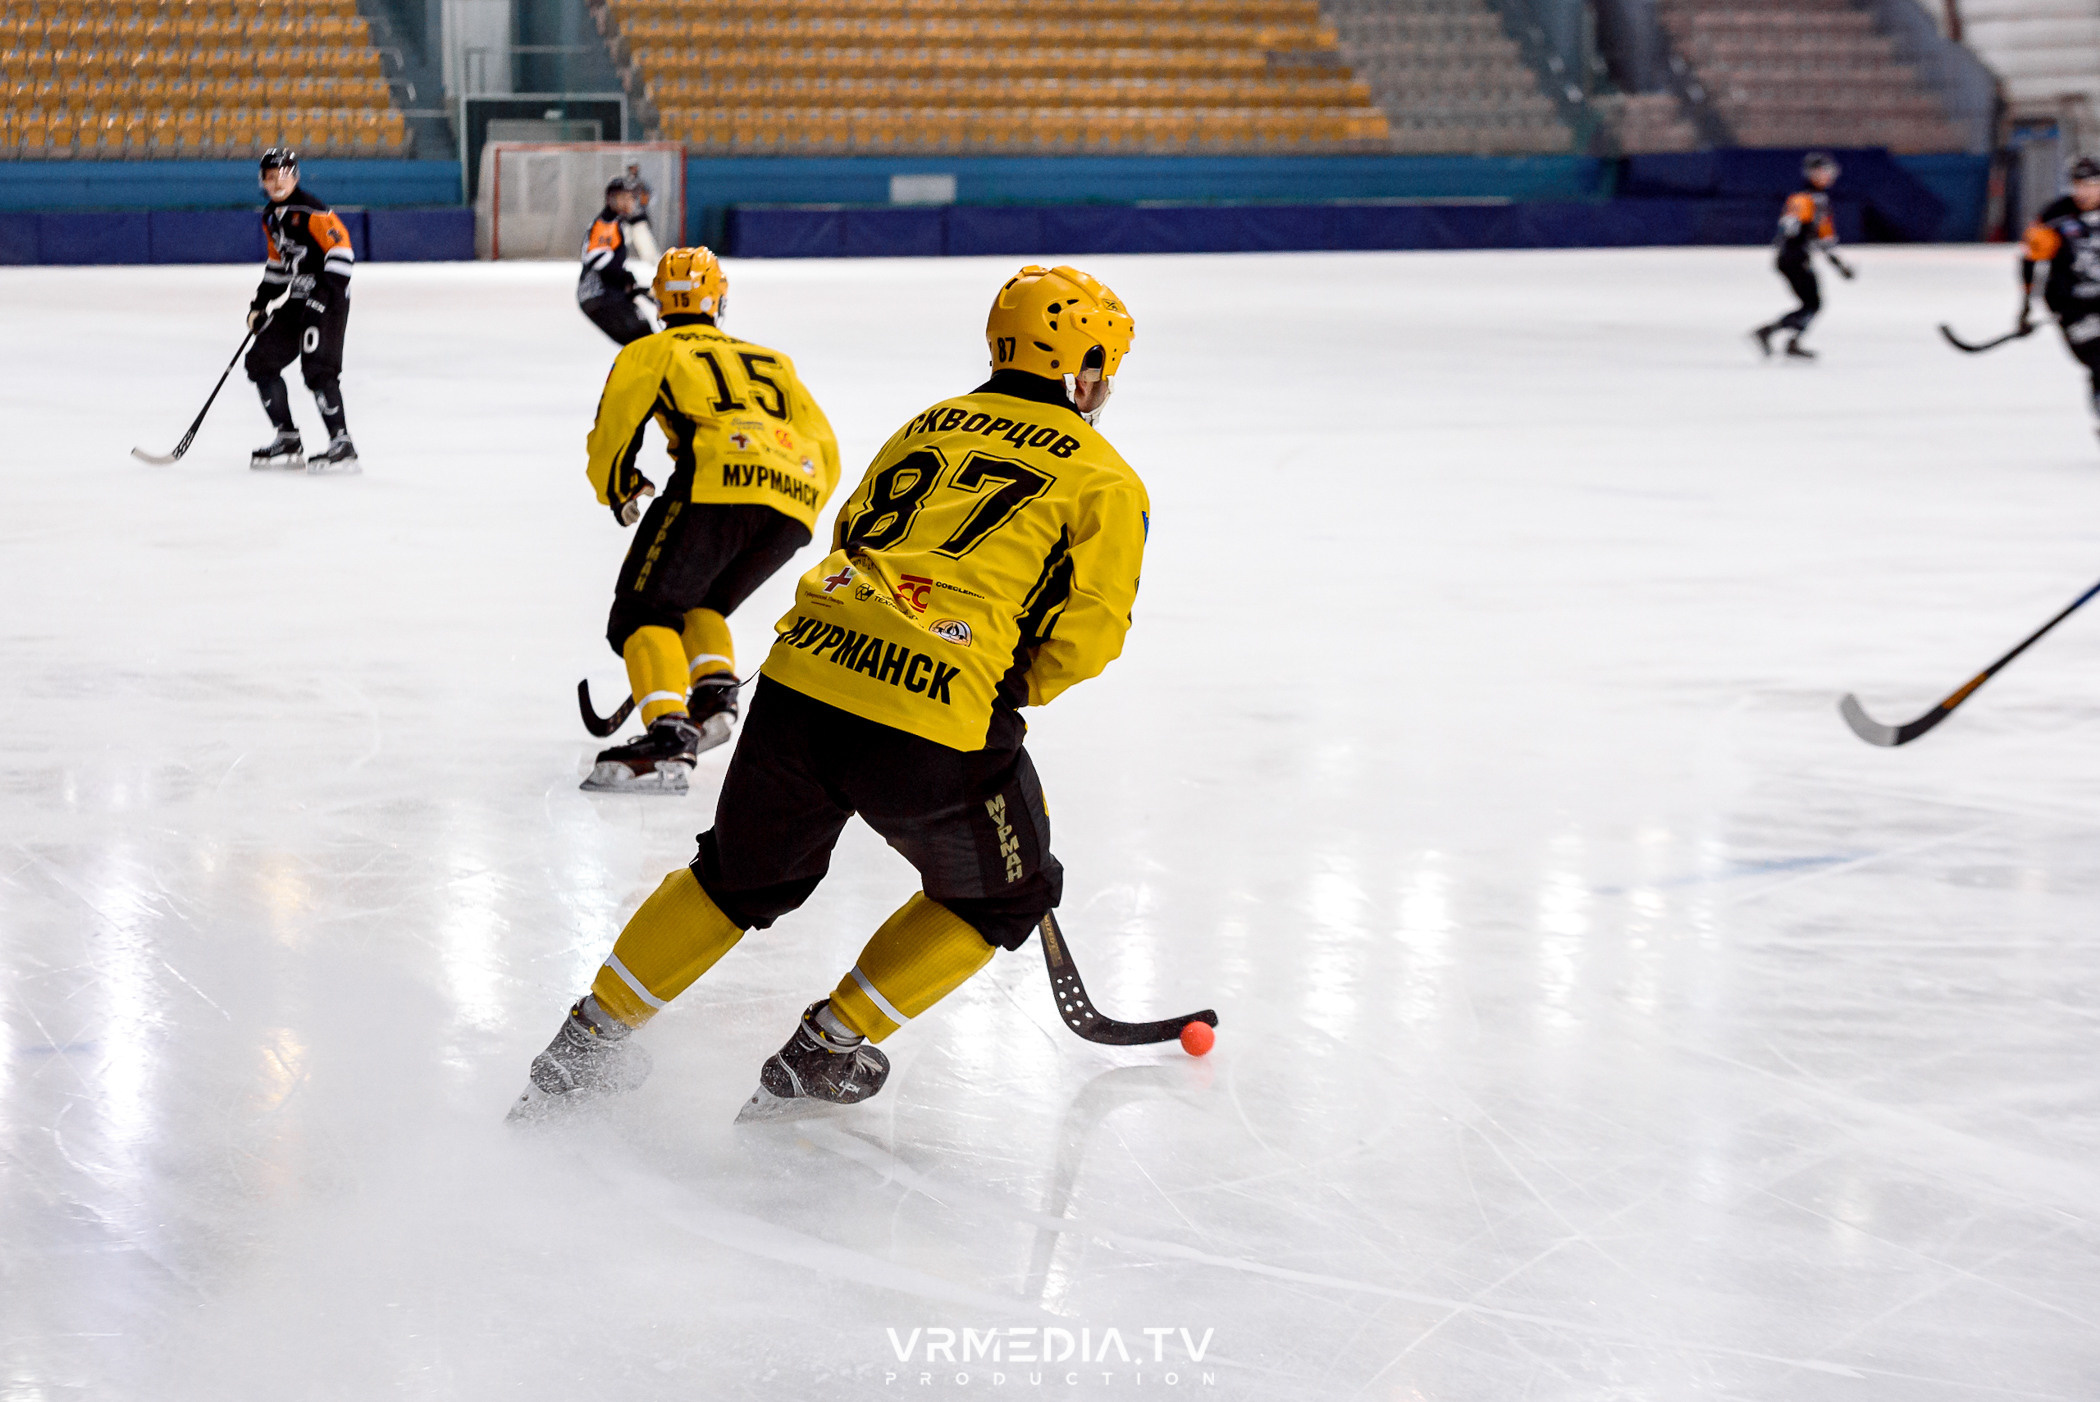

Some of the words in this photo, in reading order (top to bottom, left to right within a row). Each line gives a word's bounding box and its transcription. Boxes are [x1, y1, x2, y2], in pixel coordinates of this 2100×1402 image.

[672, 292, 691, 308] 15
[997, 337, 1016, 362] 87
[690, 348, 793, 424] 15
[904, 407, 1081, 459] СКВОРЦОВ
[722, 464, 821, 511] МУРМАНСК
[847, 445, 1058, 561] 87
[781, 616, 961, 706] МУРМАНСК
[984, 793, 1024, 883] МУРМАН
